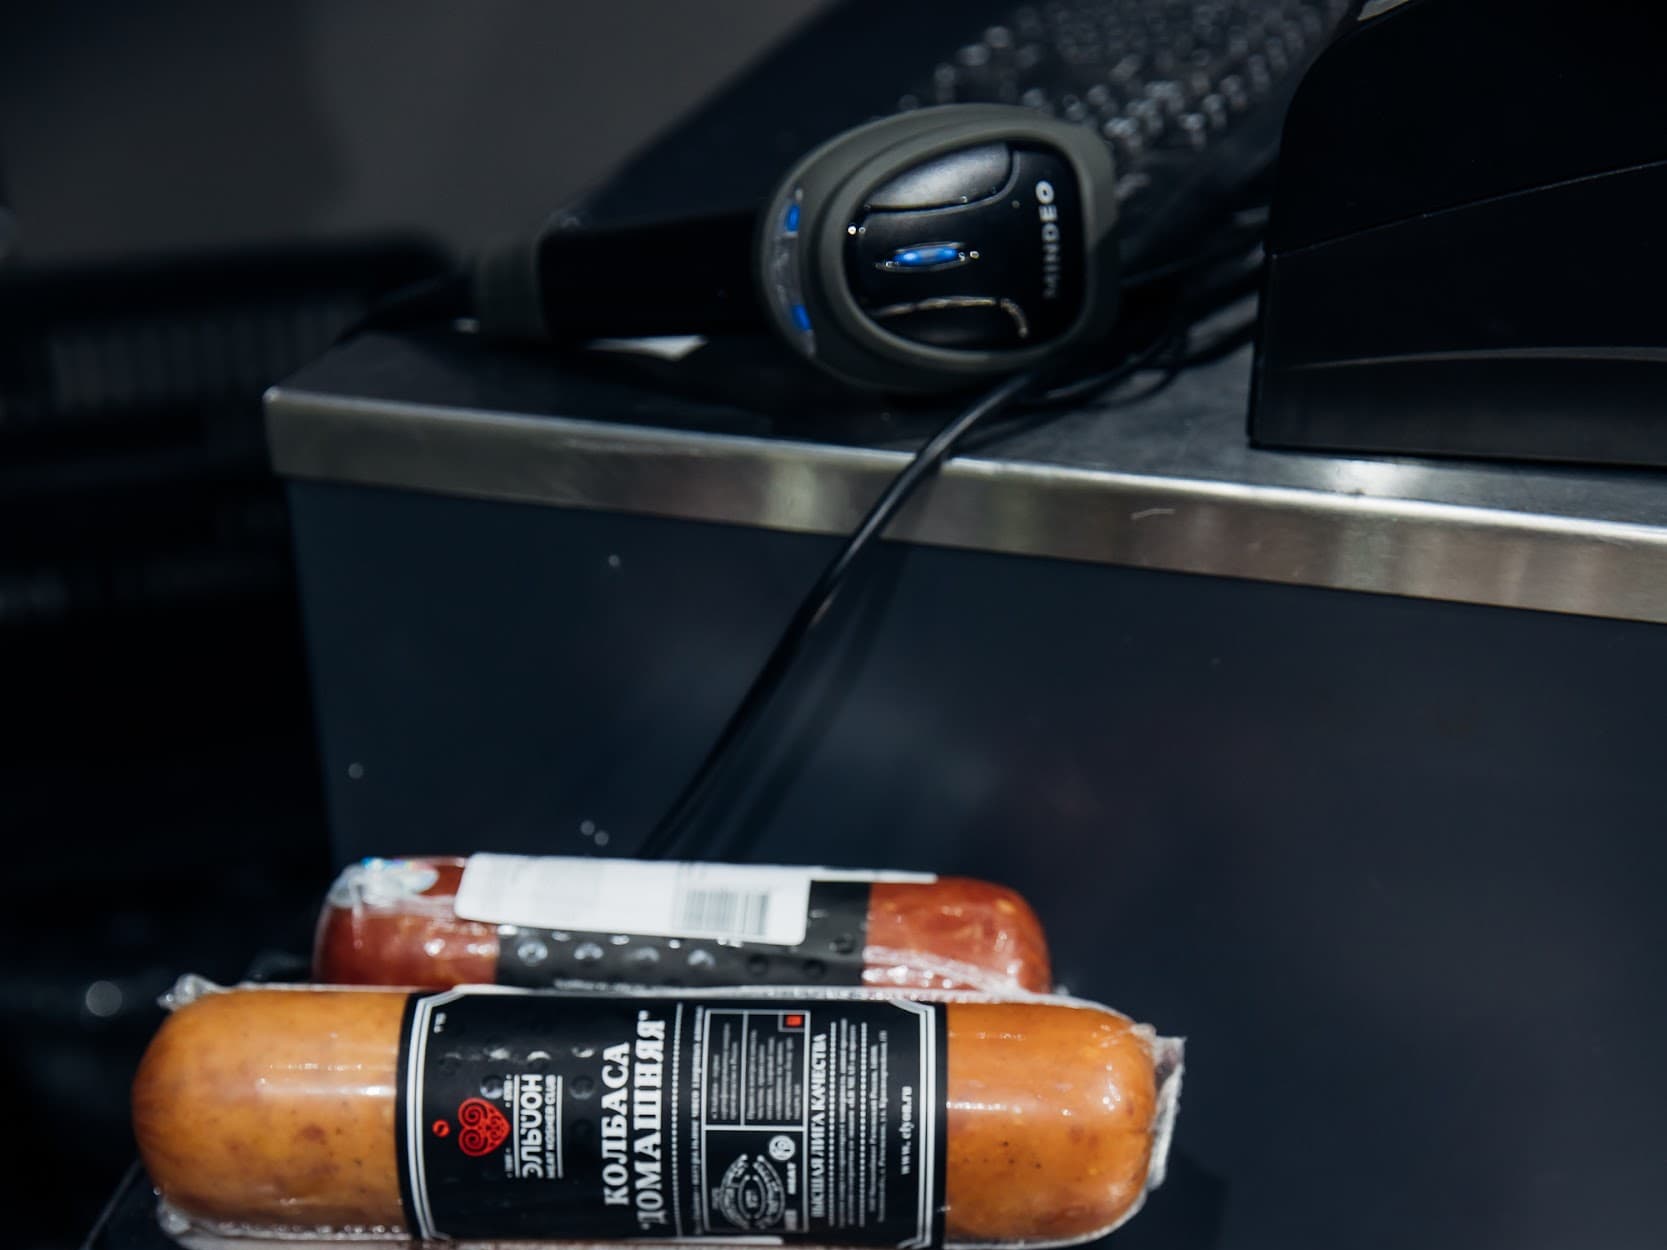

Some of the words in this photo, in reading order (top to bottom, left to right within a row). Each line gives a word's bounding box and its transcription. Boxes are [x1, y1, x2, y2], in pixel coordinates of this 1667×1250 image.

[811, 1033, 828, 1111] КАЧЕСТВА
[601, 1042, 631, 1207] КОЛБАСА
[810, 1113, 826, 1157] ЛИГА
